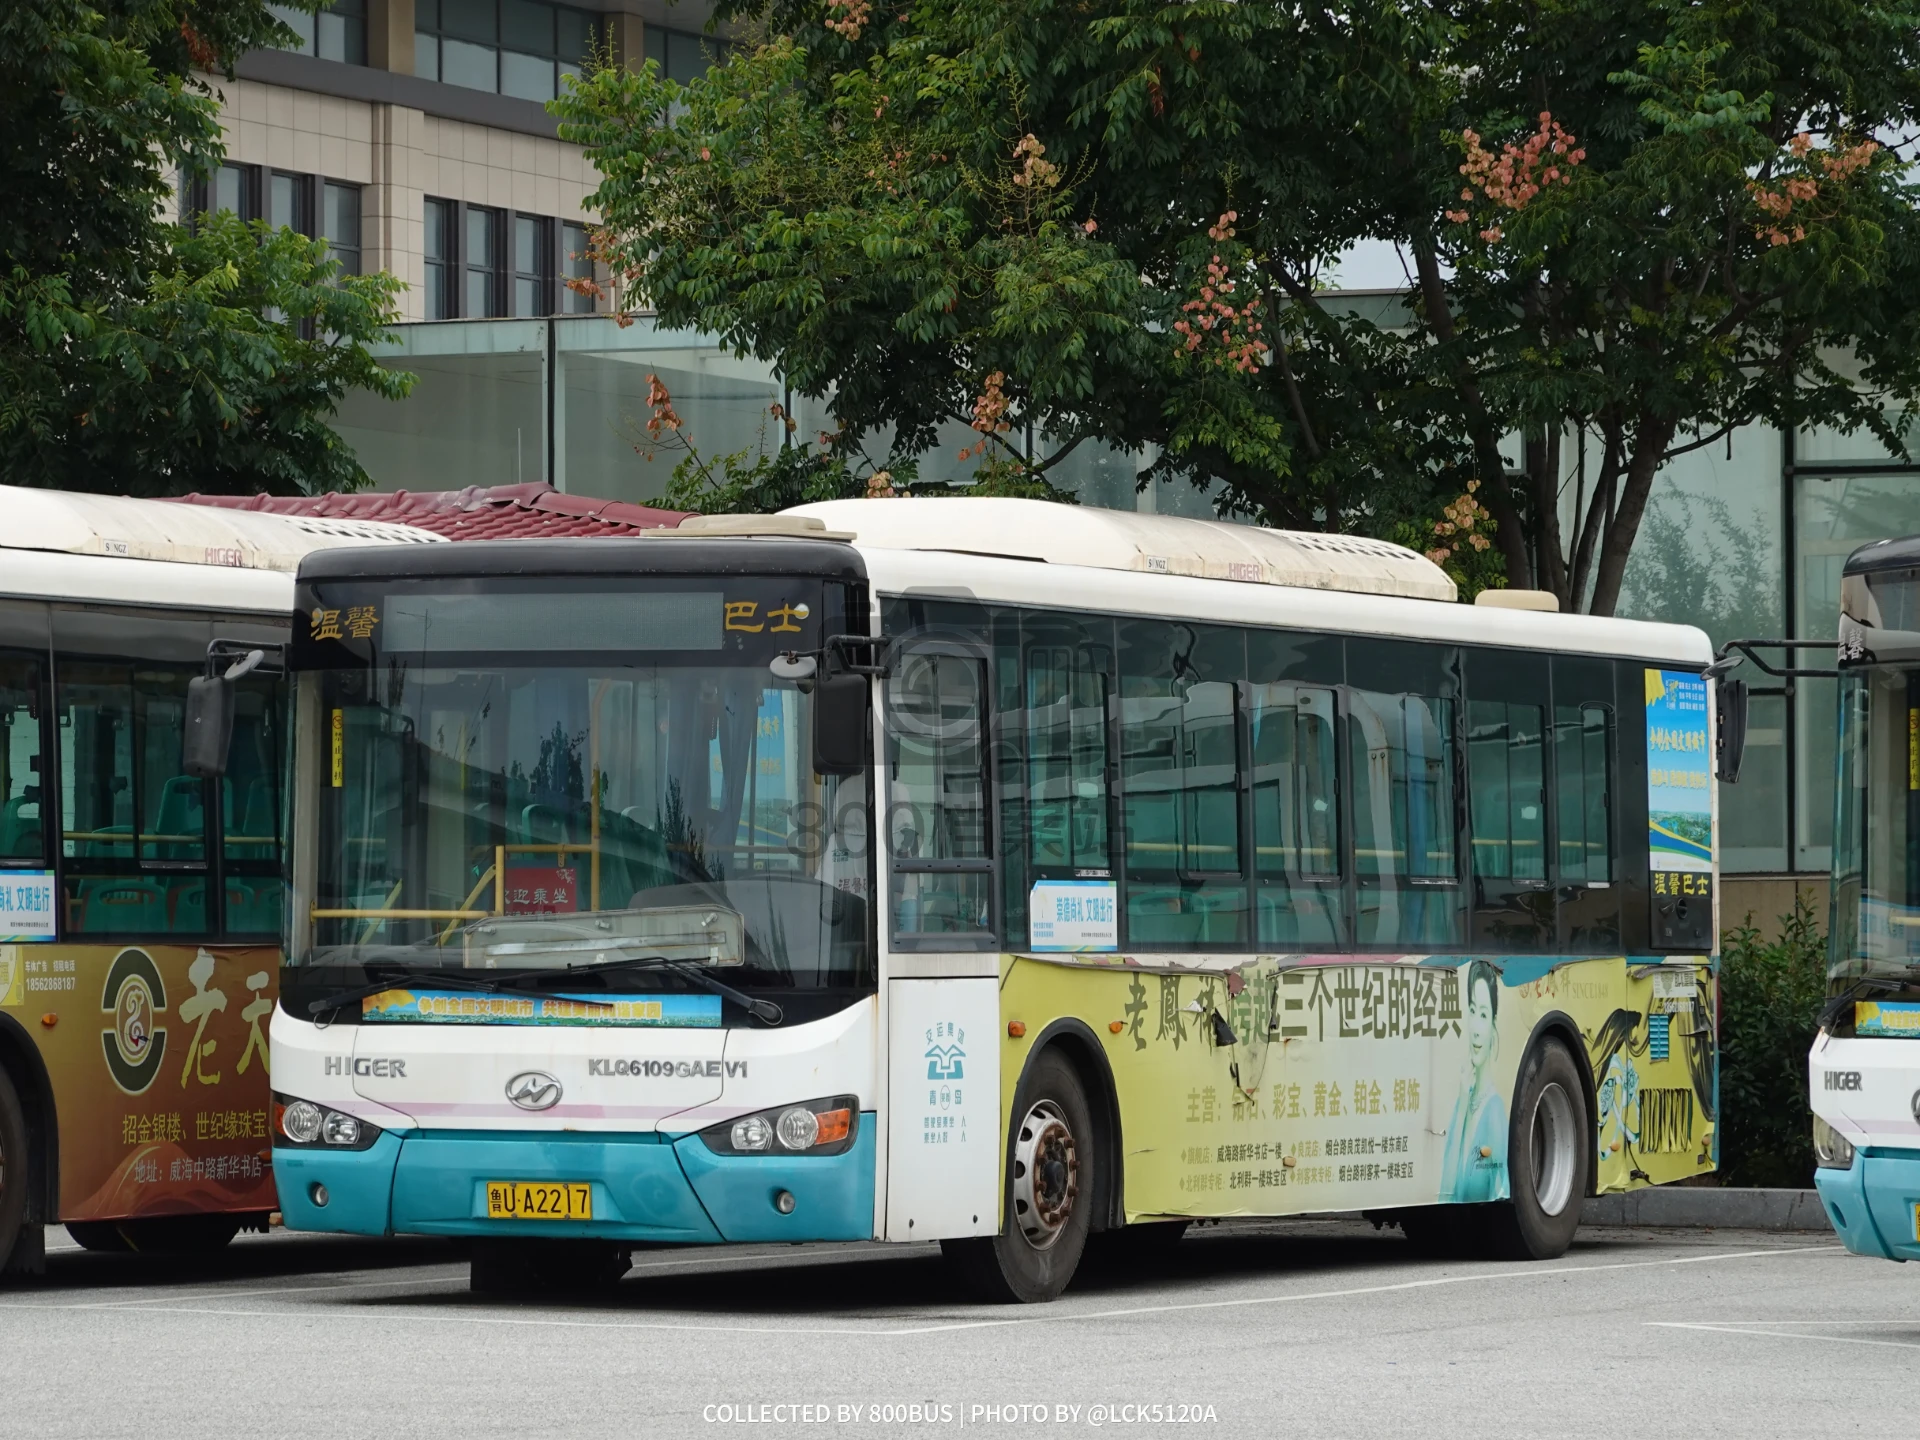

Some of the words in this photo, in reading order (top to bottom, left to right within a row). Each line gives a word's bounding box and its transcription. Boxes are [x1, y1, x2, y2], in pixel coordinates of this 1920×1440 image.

[105, 542, 127, 554] SNGZ
[205, 547, 243, 566] HIGER
[1229, 563, 1260, 582] HIGER
[311, 606, 380, 641] 温馨
[724, 600, 808, 633] 巴士
[1655, 873, 1709, 896] 温馨巴士
[17, 886, 50, 912] 文明出行
[1056, 897, 1084, 922] 崇德尚礼
[1086, 897, 1113, 922] 文明出行
[418, 997, 534, 1017] 争创全国文明城市
[324, 1056, 407, 1078] HIGER
[1824, 1070, 1863, 1092] HIGER
